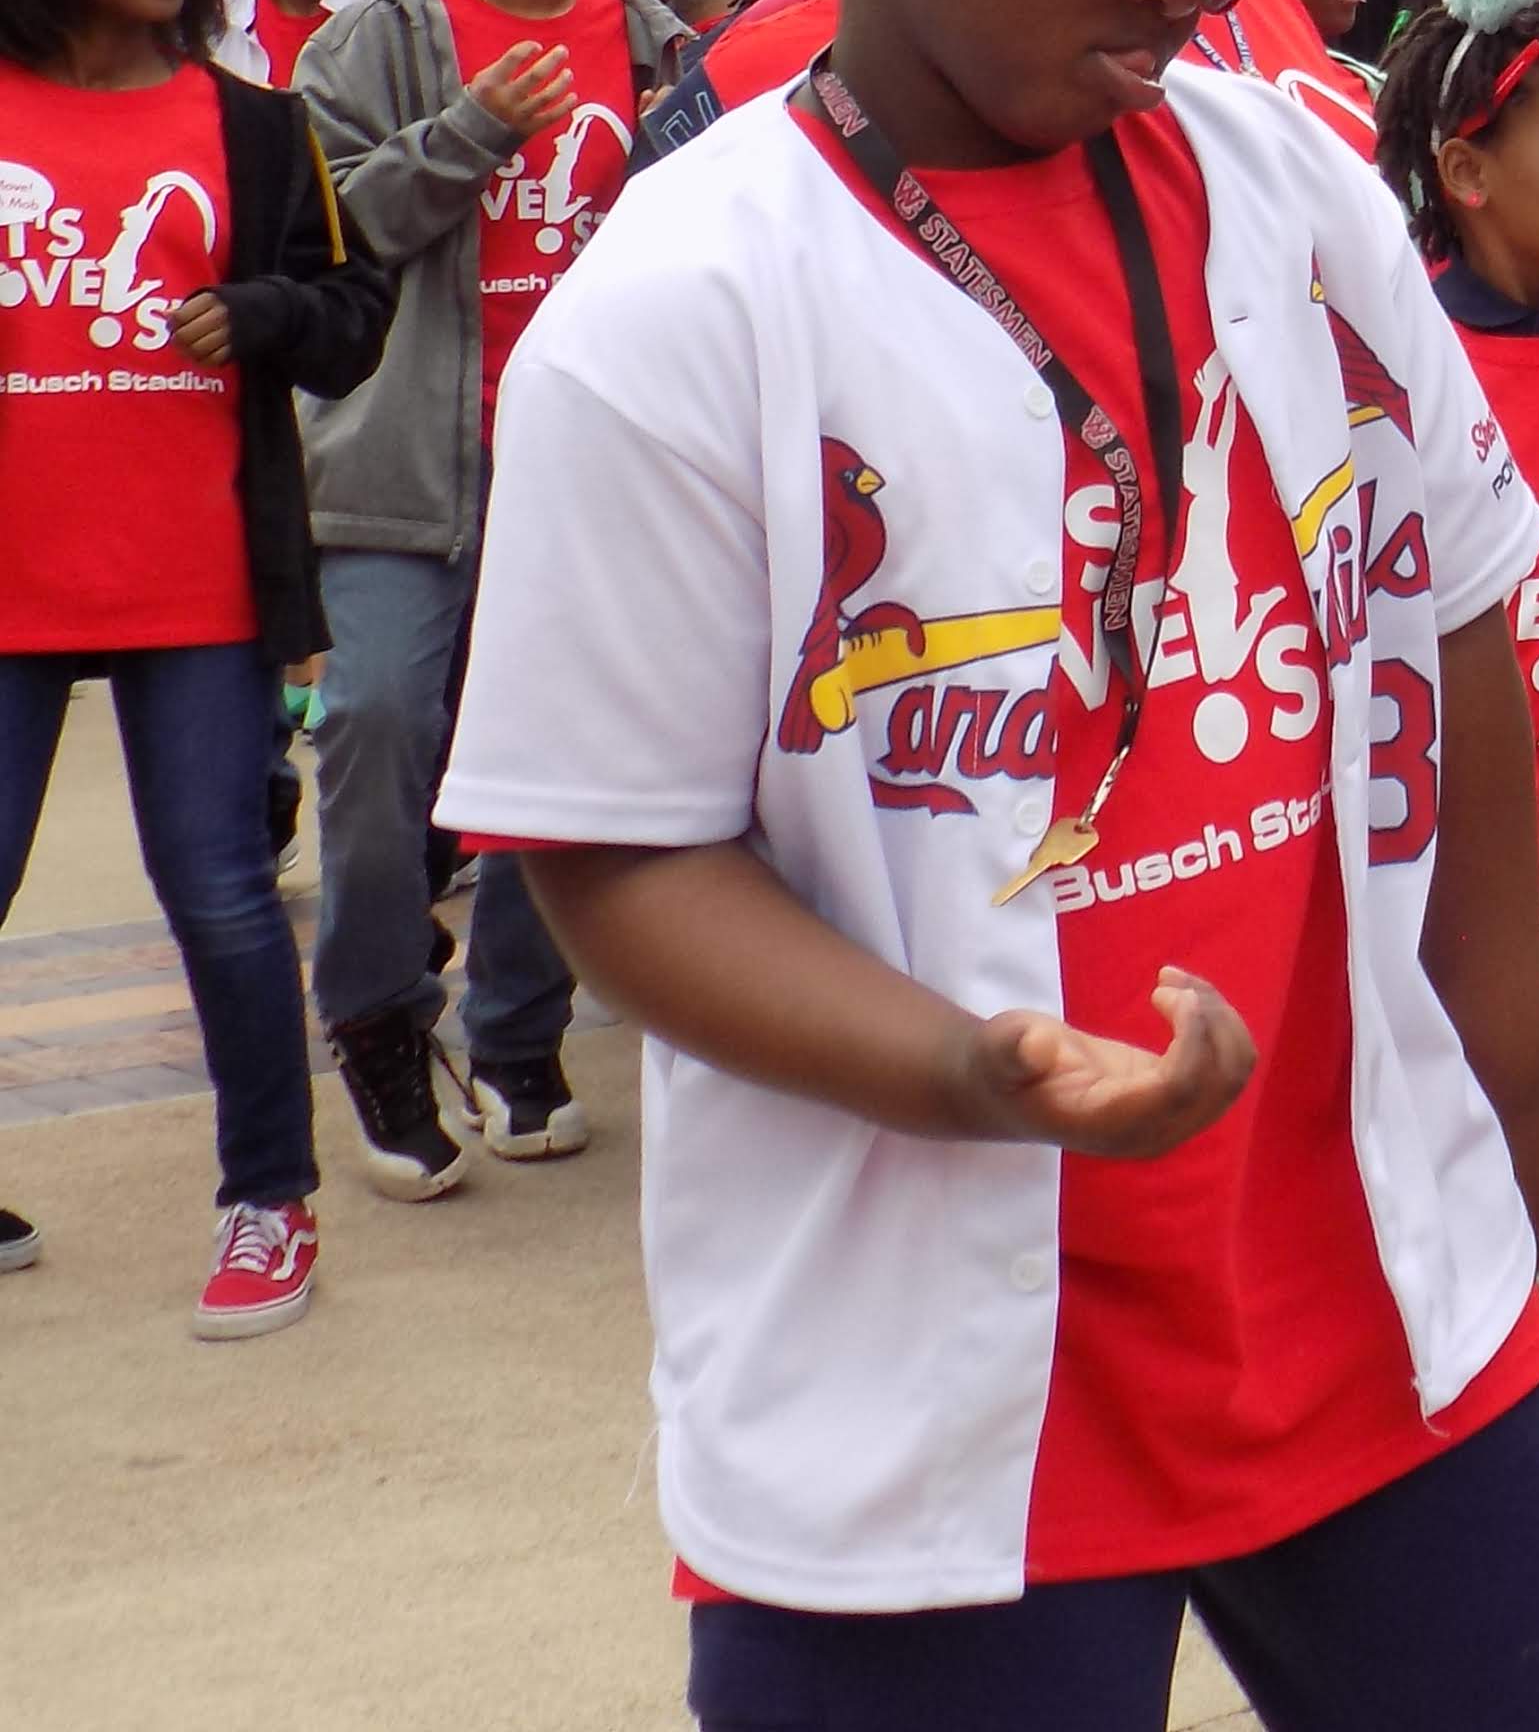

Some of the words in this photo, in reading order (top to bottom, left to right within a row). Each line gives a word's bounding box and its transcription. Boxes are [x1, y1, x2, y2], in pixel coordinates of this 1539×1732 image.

[918, 212, 1053, 370] STATESMEN
[7, 370, 102, 394] Busch
[108, 369, 225, 394] Stadium
[1103, 447, 1143, 632] STATESMEN
[1052, 823, 1243, 914] Busch
